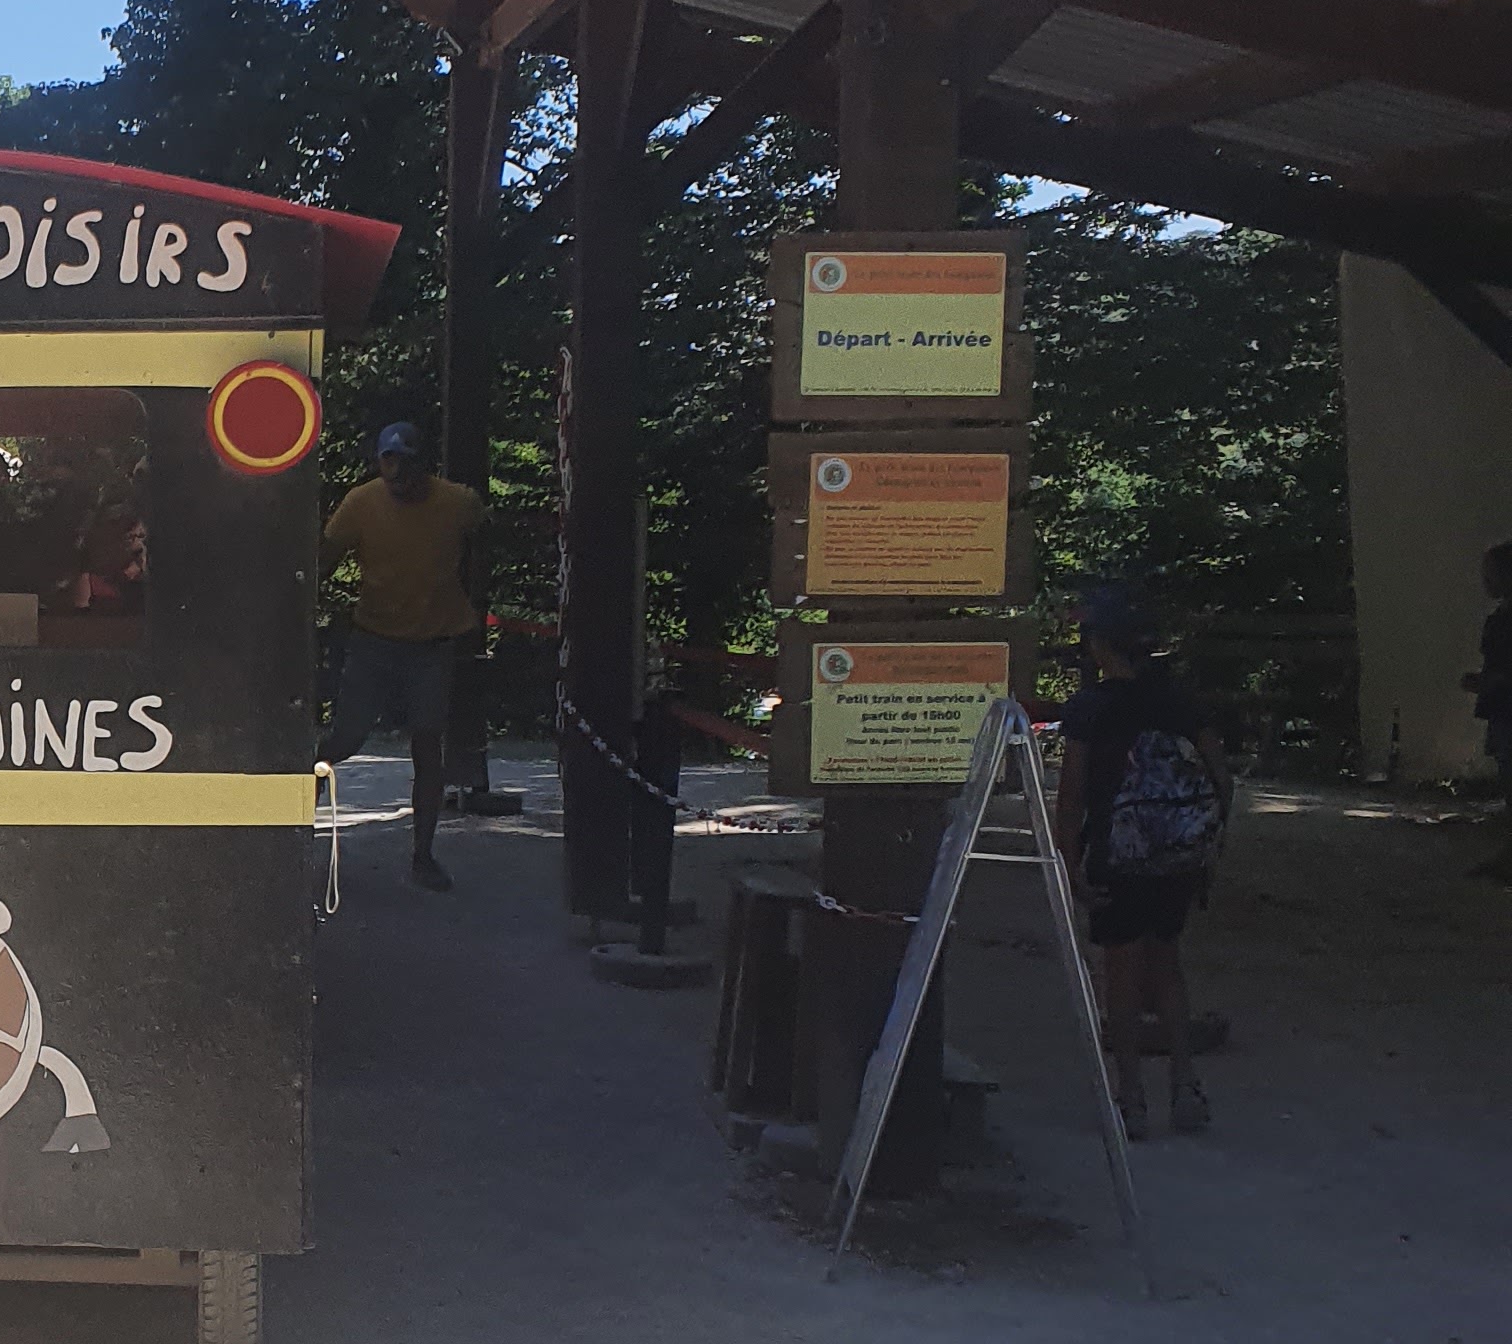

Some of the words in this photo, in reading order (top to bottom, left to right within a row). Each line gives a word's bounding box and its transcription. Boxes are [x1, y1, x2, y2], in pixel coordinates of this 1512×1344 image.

[817, 329, 892, 351] Départ
[911, 329, 992, 348] Arrivée
[836, 693, 869, 705] Petit
[871, 693, 903, 705] train
[925, 693, 975, 704] service
[860, 710, 899, 723] partir
